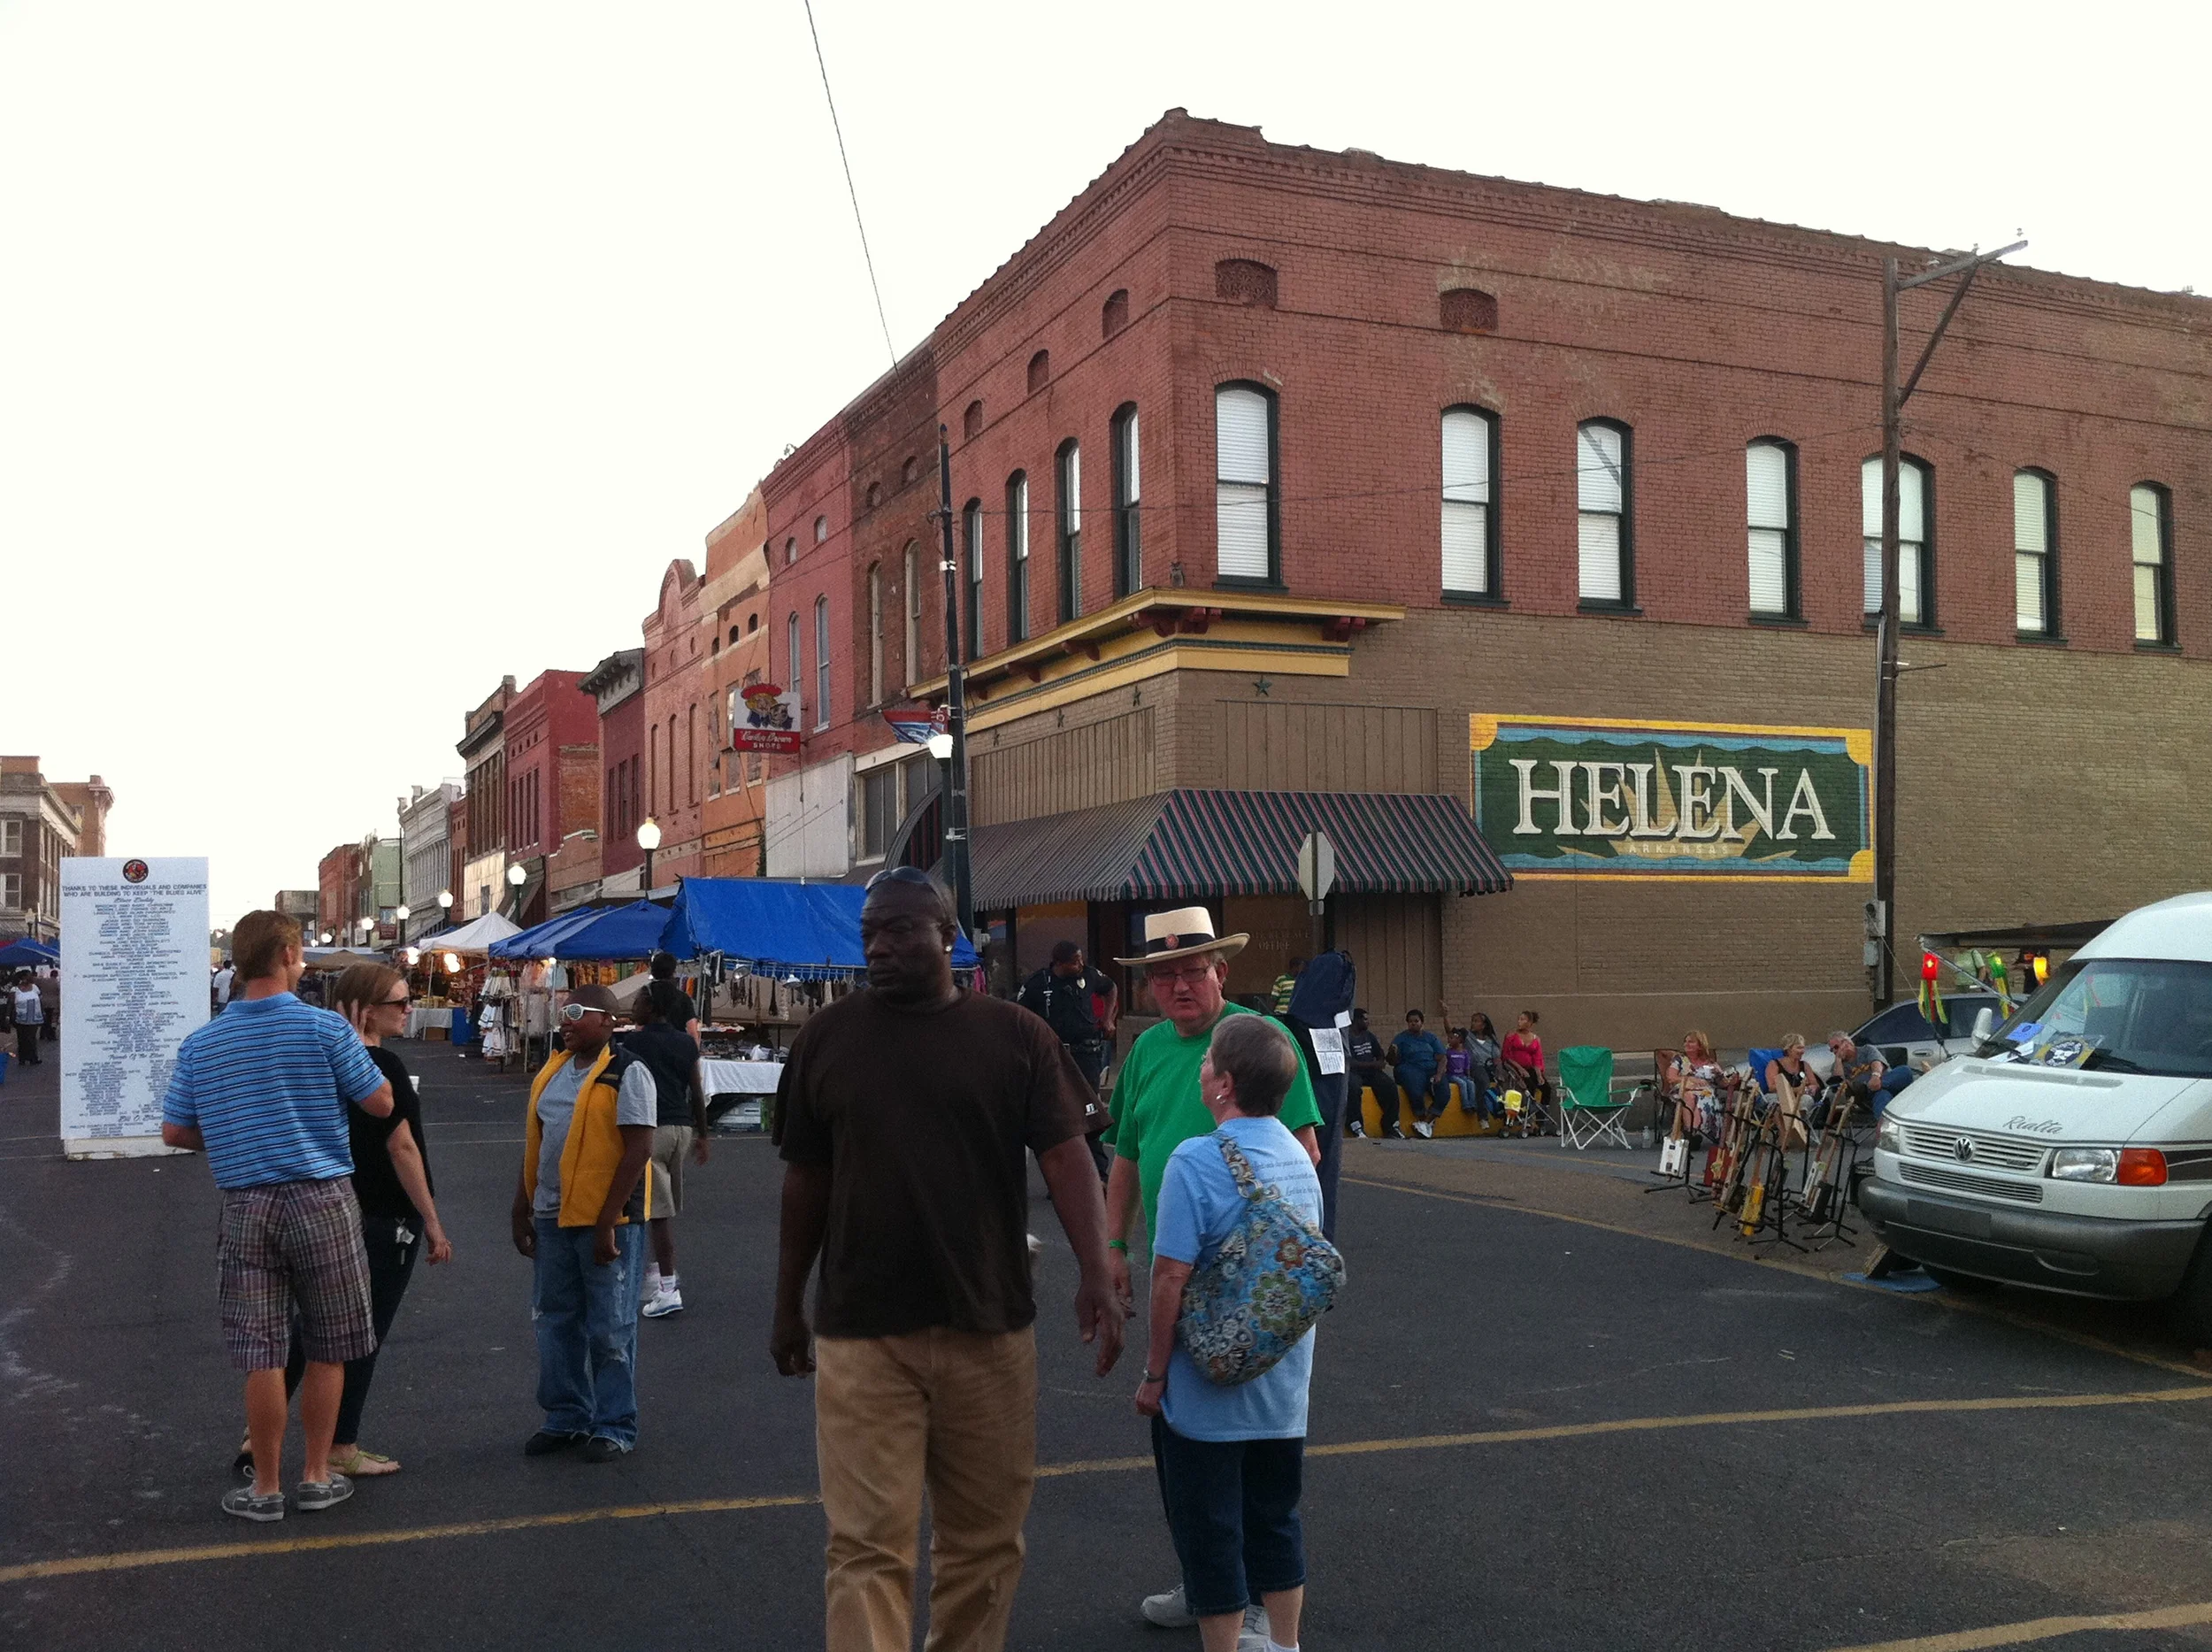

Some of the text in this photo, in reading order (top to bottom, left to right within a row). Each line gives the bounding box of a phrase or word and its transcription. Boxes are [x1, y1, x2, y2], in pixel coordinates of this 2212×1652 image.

[1508, 758, 1836, 842] HELENA
[1628, 843, 1729, 856] ARKANSAS
[2002, 1116, 2063, 1135] Rialta
